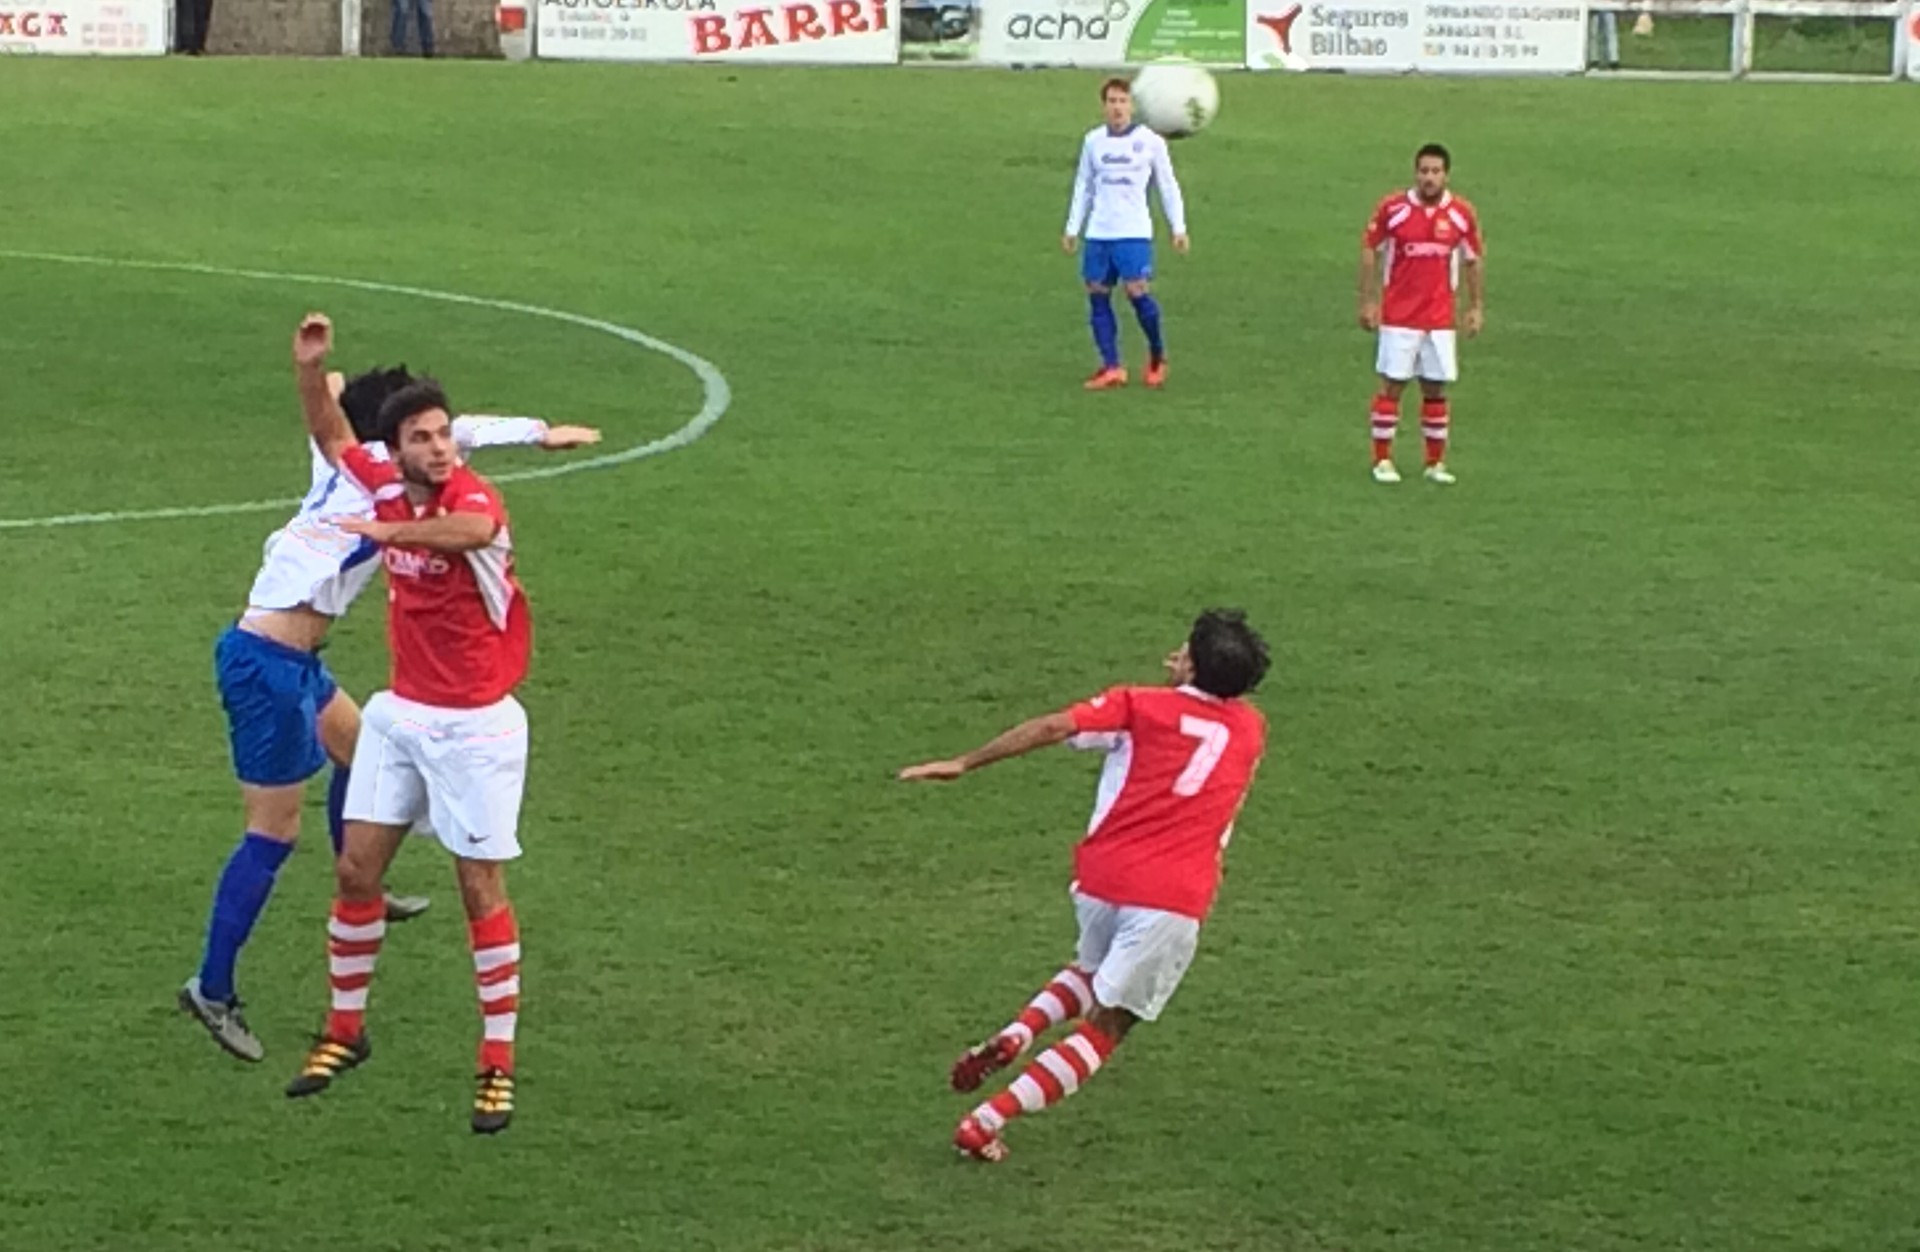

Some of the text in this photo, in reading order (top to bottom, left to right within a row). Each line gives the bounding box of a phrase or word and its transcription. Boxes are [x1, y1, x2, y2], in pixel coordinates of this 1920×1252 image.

[1309, 6, 1409, 29] Seguros
[1309, 32, 1388, 56] Bilbao
[1171, 713, 1230, 797] 7
